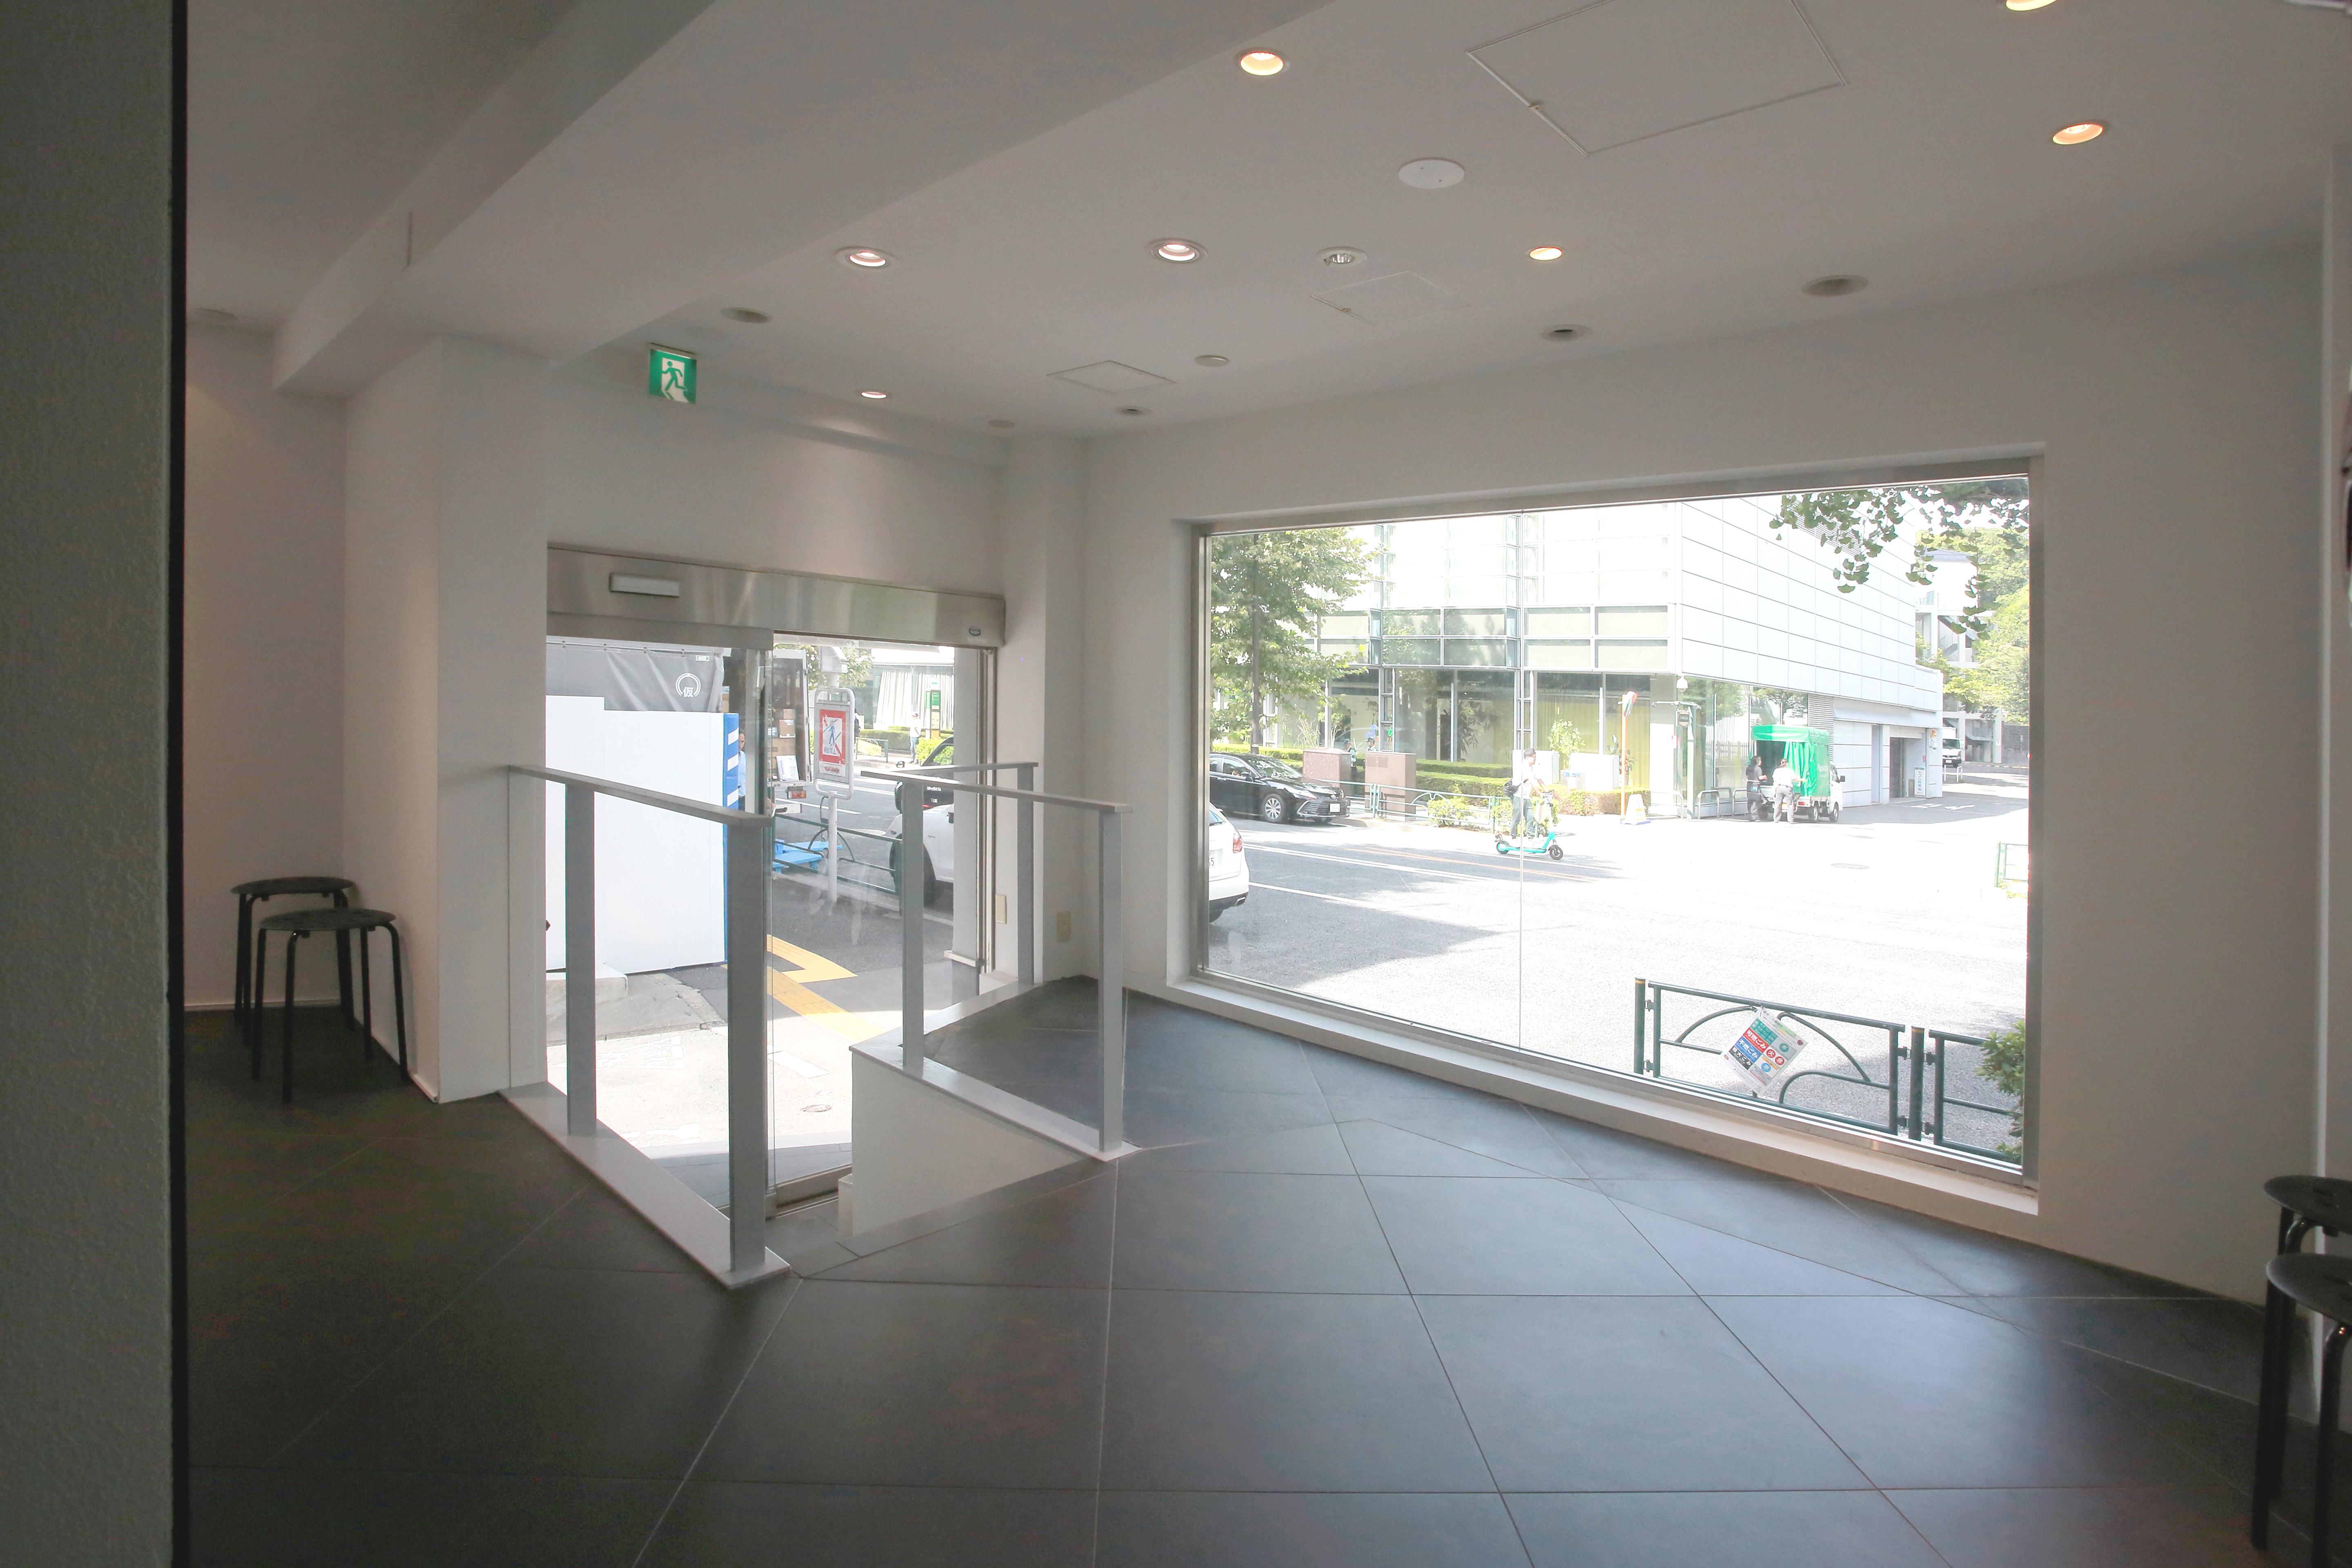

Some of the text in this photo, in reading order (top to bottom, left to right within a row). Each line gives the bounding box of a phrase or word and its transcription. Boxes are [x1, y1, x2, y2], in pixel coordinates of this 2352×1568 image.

[683, 687, 694, 697] 仮
[824, 746, 836, 755] 横断禁止
[1746, 1029, 1766, 1049] 可燃ごみ
[1739, 1038, 1758, 1058] 不燃ごみ
